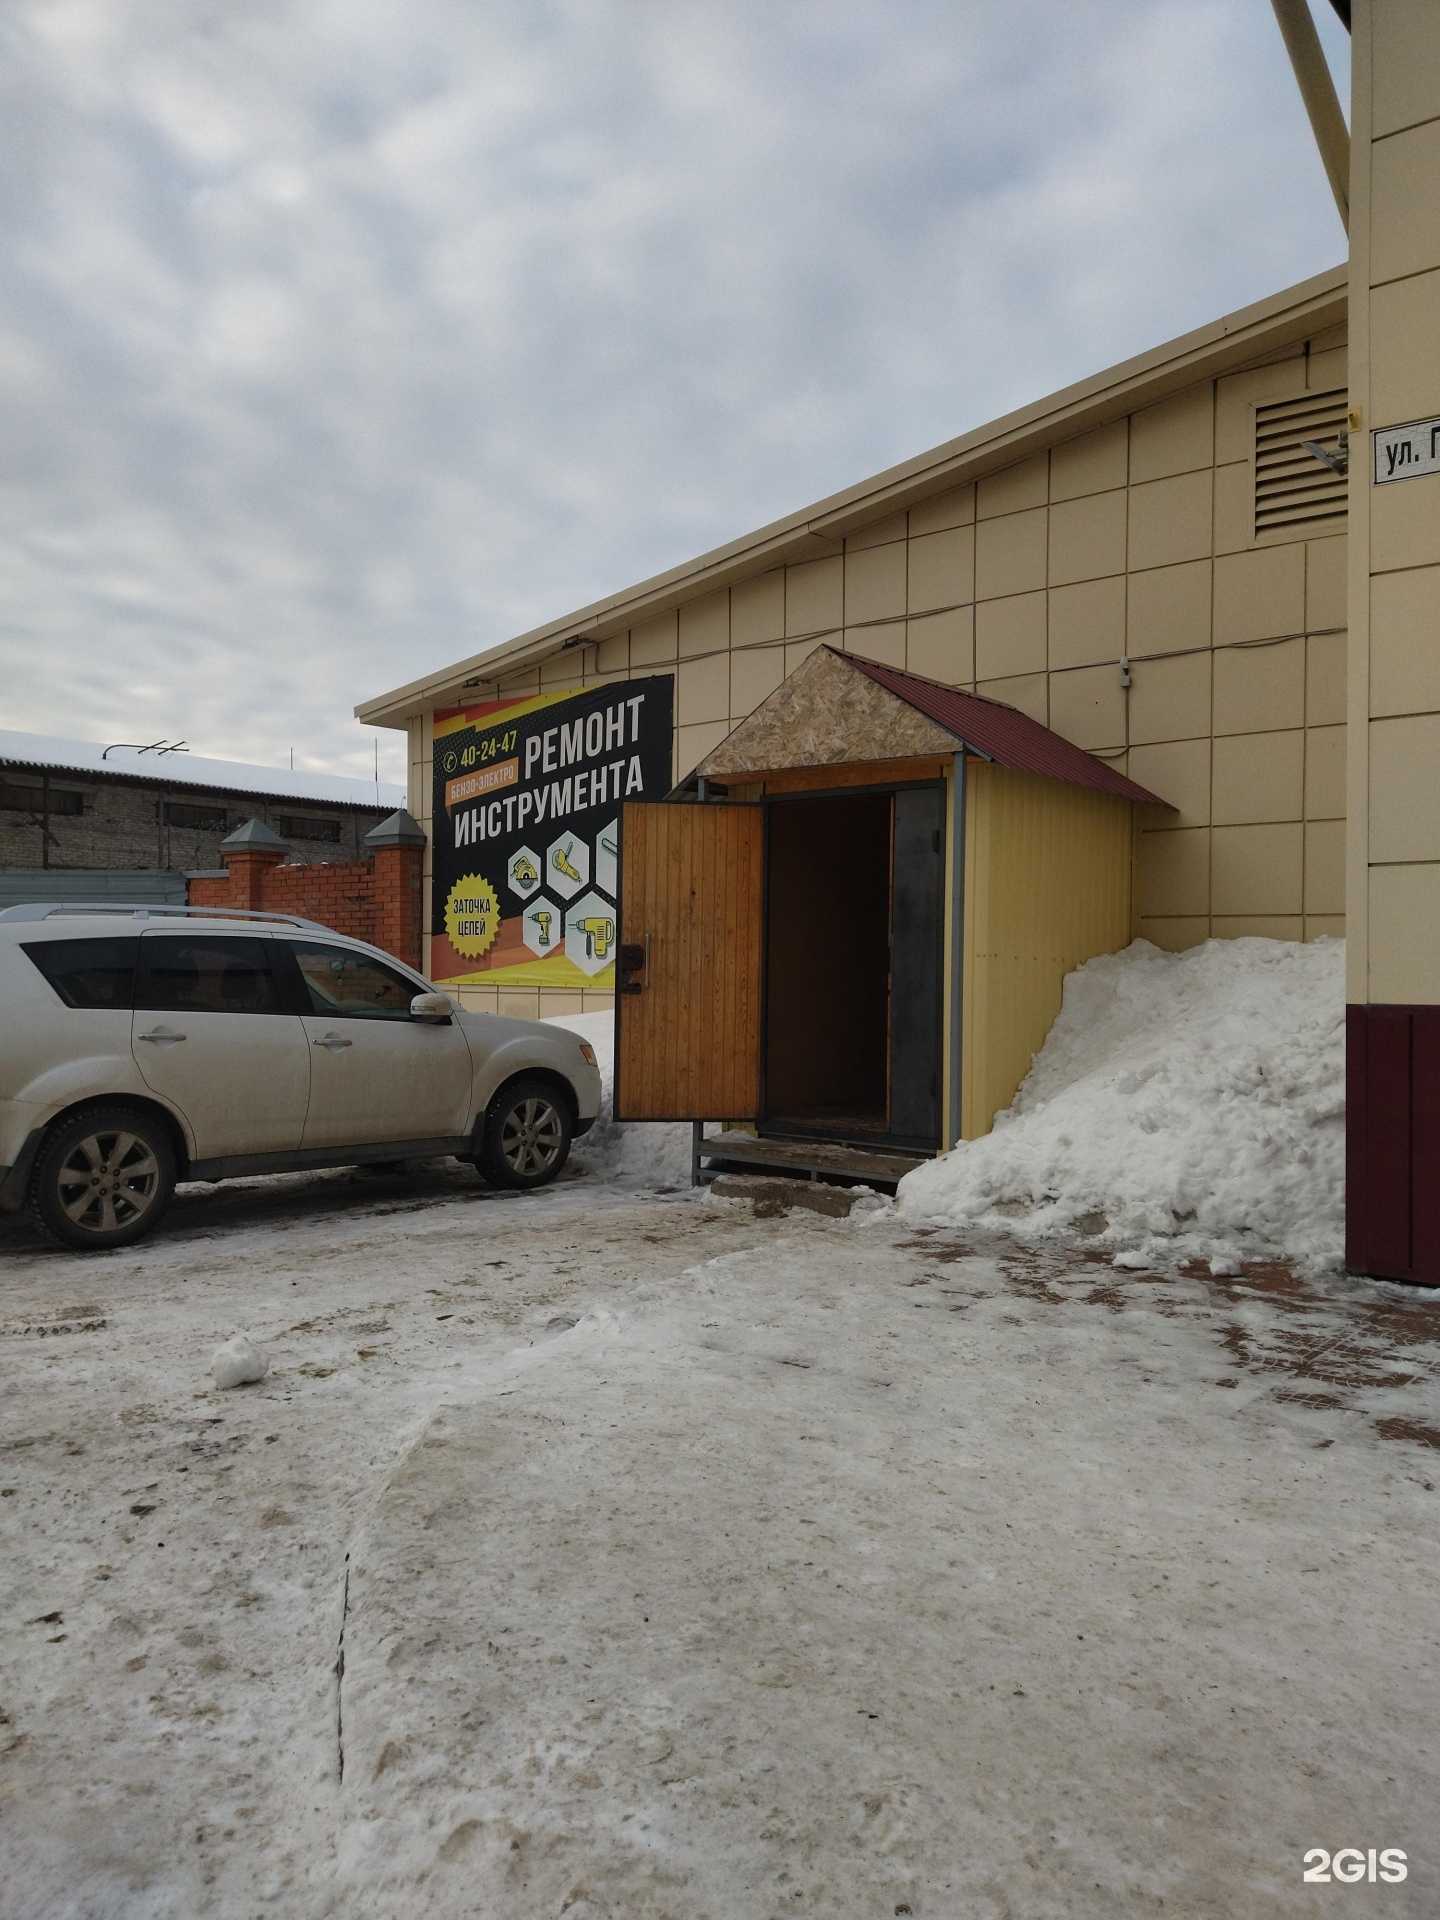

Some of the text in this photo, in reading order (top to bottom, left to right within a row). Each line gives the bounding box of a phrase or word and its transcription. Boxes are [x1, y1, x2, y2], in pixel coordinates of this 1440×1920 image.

[1386, 441, 1419, 475] ул.
[460, 730, 517, 767] 40-24-47
[525, 694, 645, 780] РЕМОНТ
[454, 755, 644, 848] ИНСТРУМЕНТА
[453, 898, 491, 915] ЗАТОЧКА
[458, 917, 486, 937] ЦЕПЕЙ
